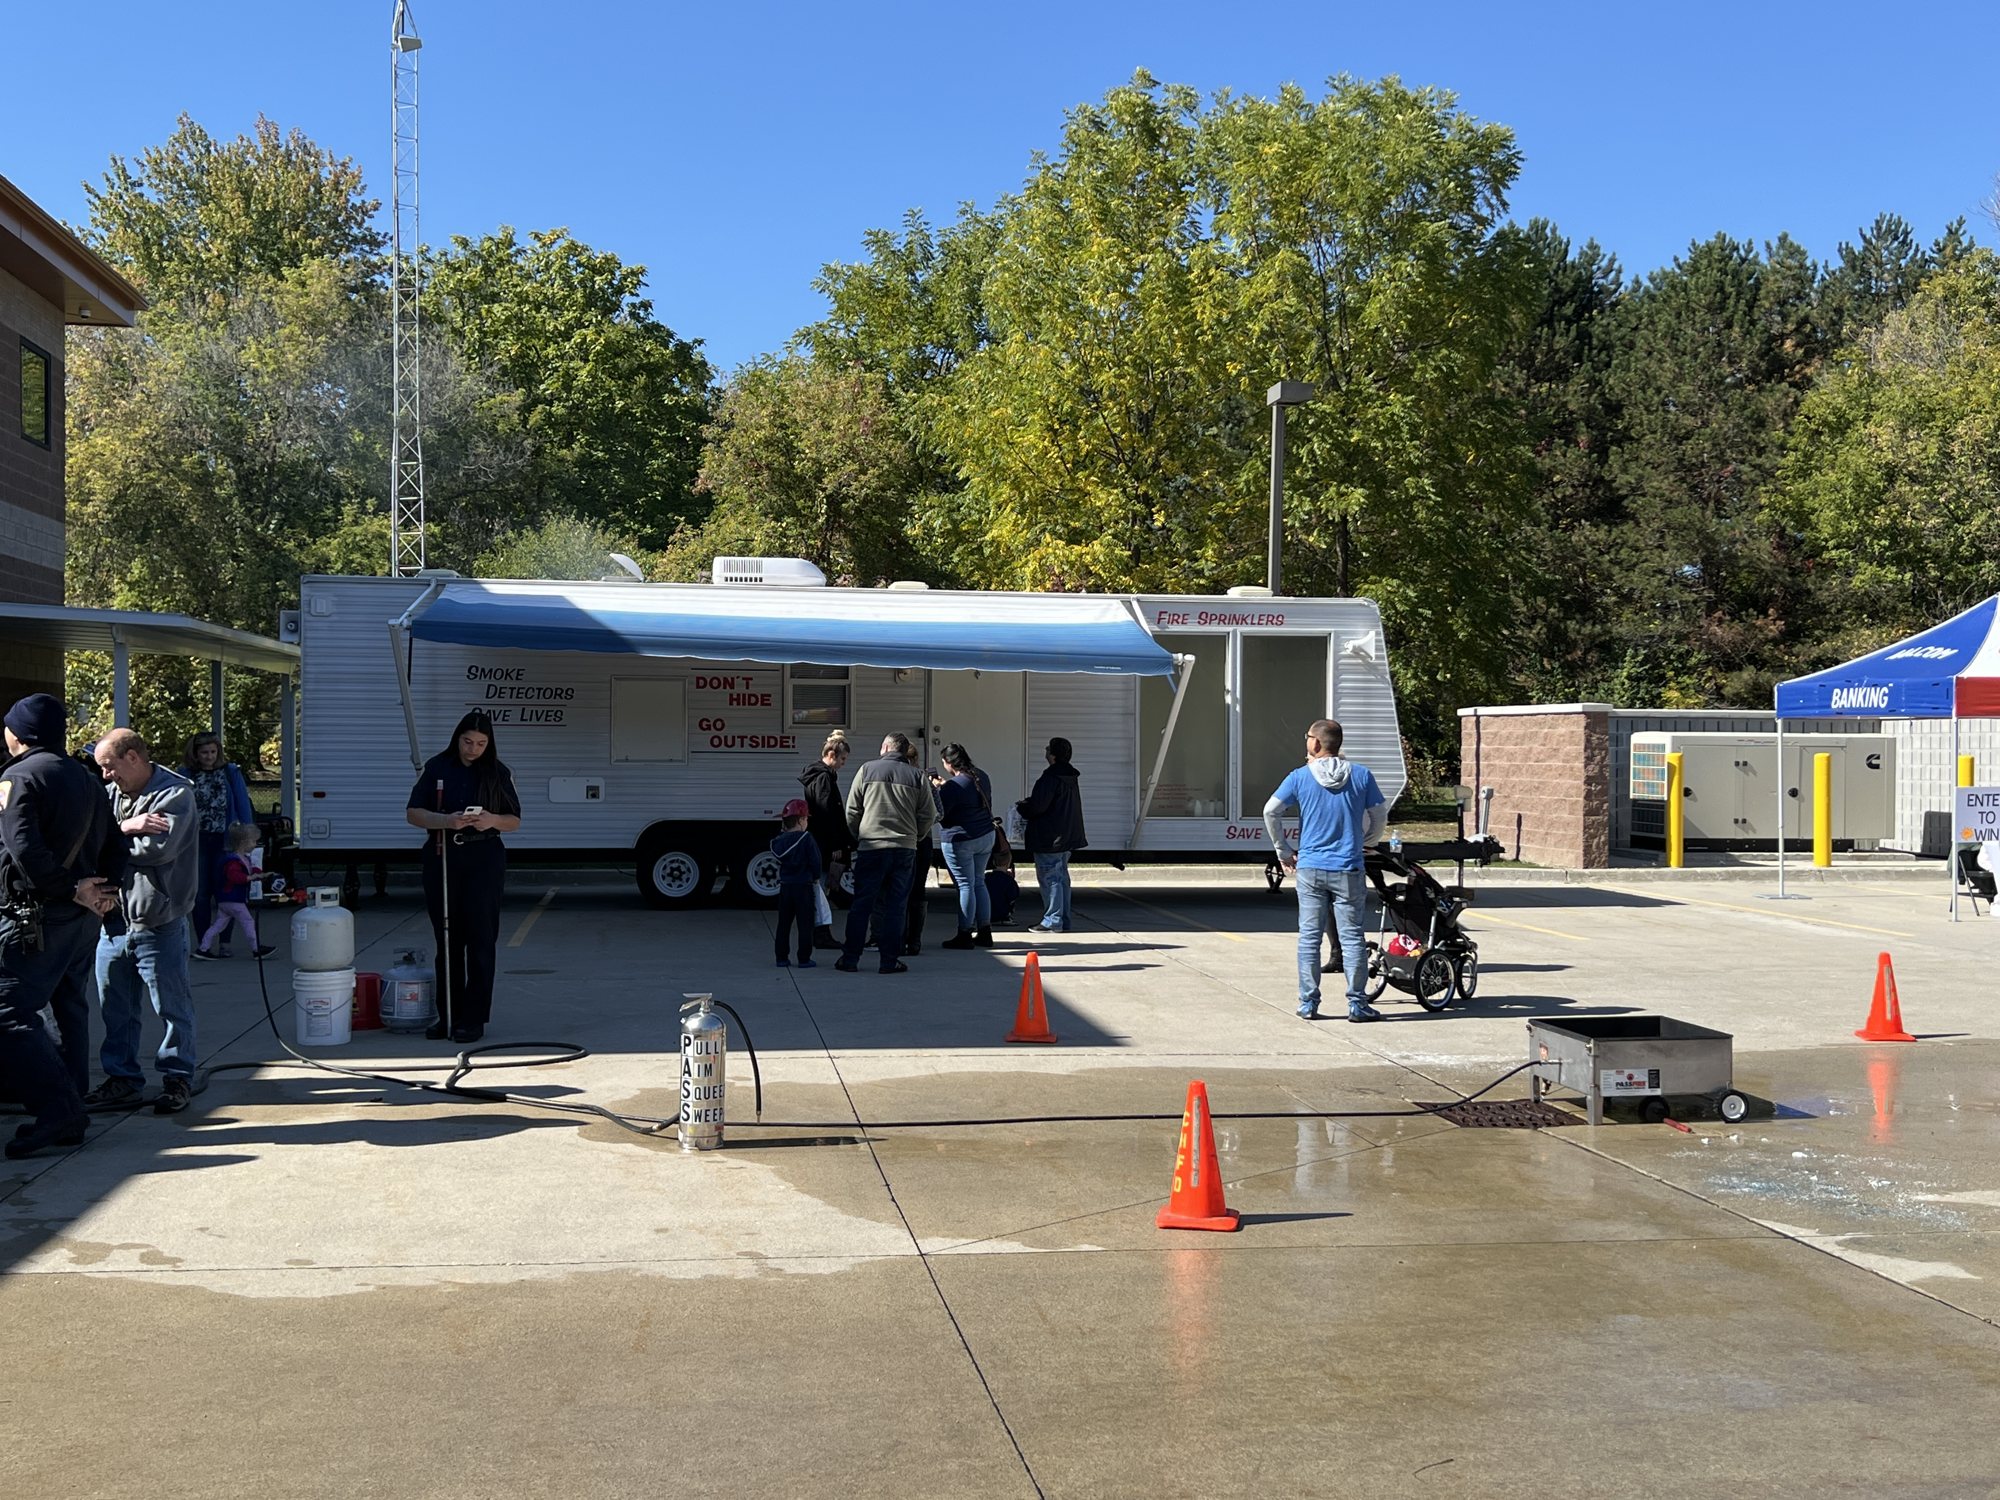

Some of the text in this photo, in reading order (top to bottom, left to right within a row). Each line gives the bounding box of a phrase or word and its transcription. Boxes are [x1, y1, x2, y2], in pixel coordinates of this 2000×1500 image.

[1157, 611, 1285, 626] FIRE SPRINKLERS
[466, 665, 525, 681] SMOKE
[485, 683, 575, 700] DETECTORS
[1831, 686, 1889, 709] BANKING
[729, 693, 772, 706] HIDE
[520, 707, 564, 722] LIVES
[698, 717, 726, 731] GO
[709, 735, 796, 748] OUTSIDE!
[1967, 793, 2000, 807] ENTE
[1978, 810, 1996, 824] TO
[1226, 825, 1263, 840] SAVE
[1974, 828, 2000, 841] WIN
[681, 1080, 725, 1100] SQUEE
